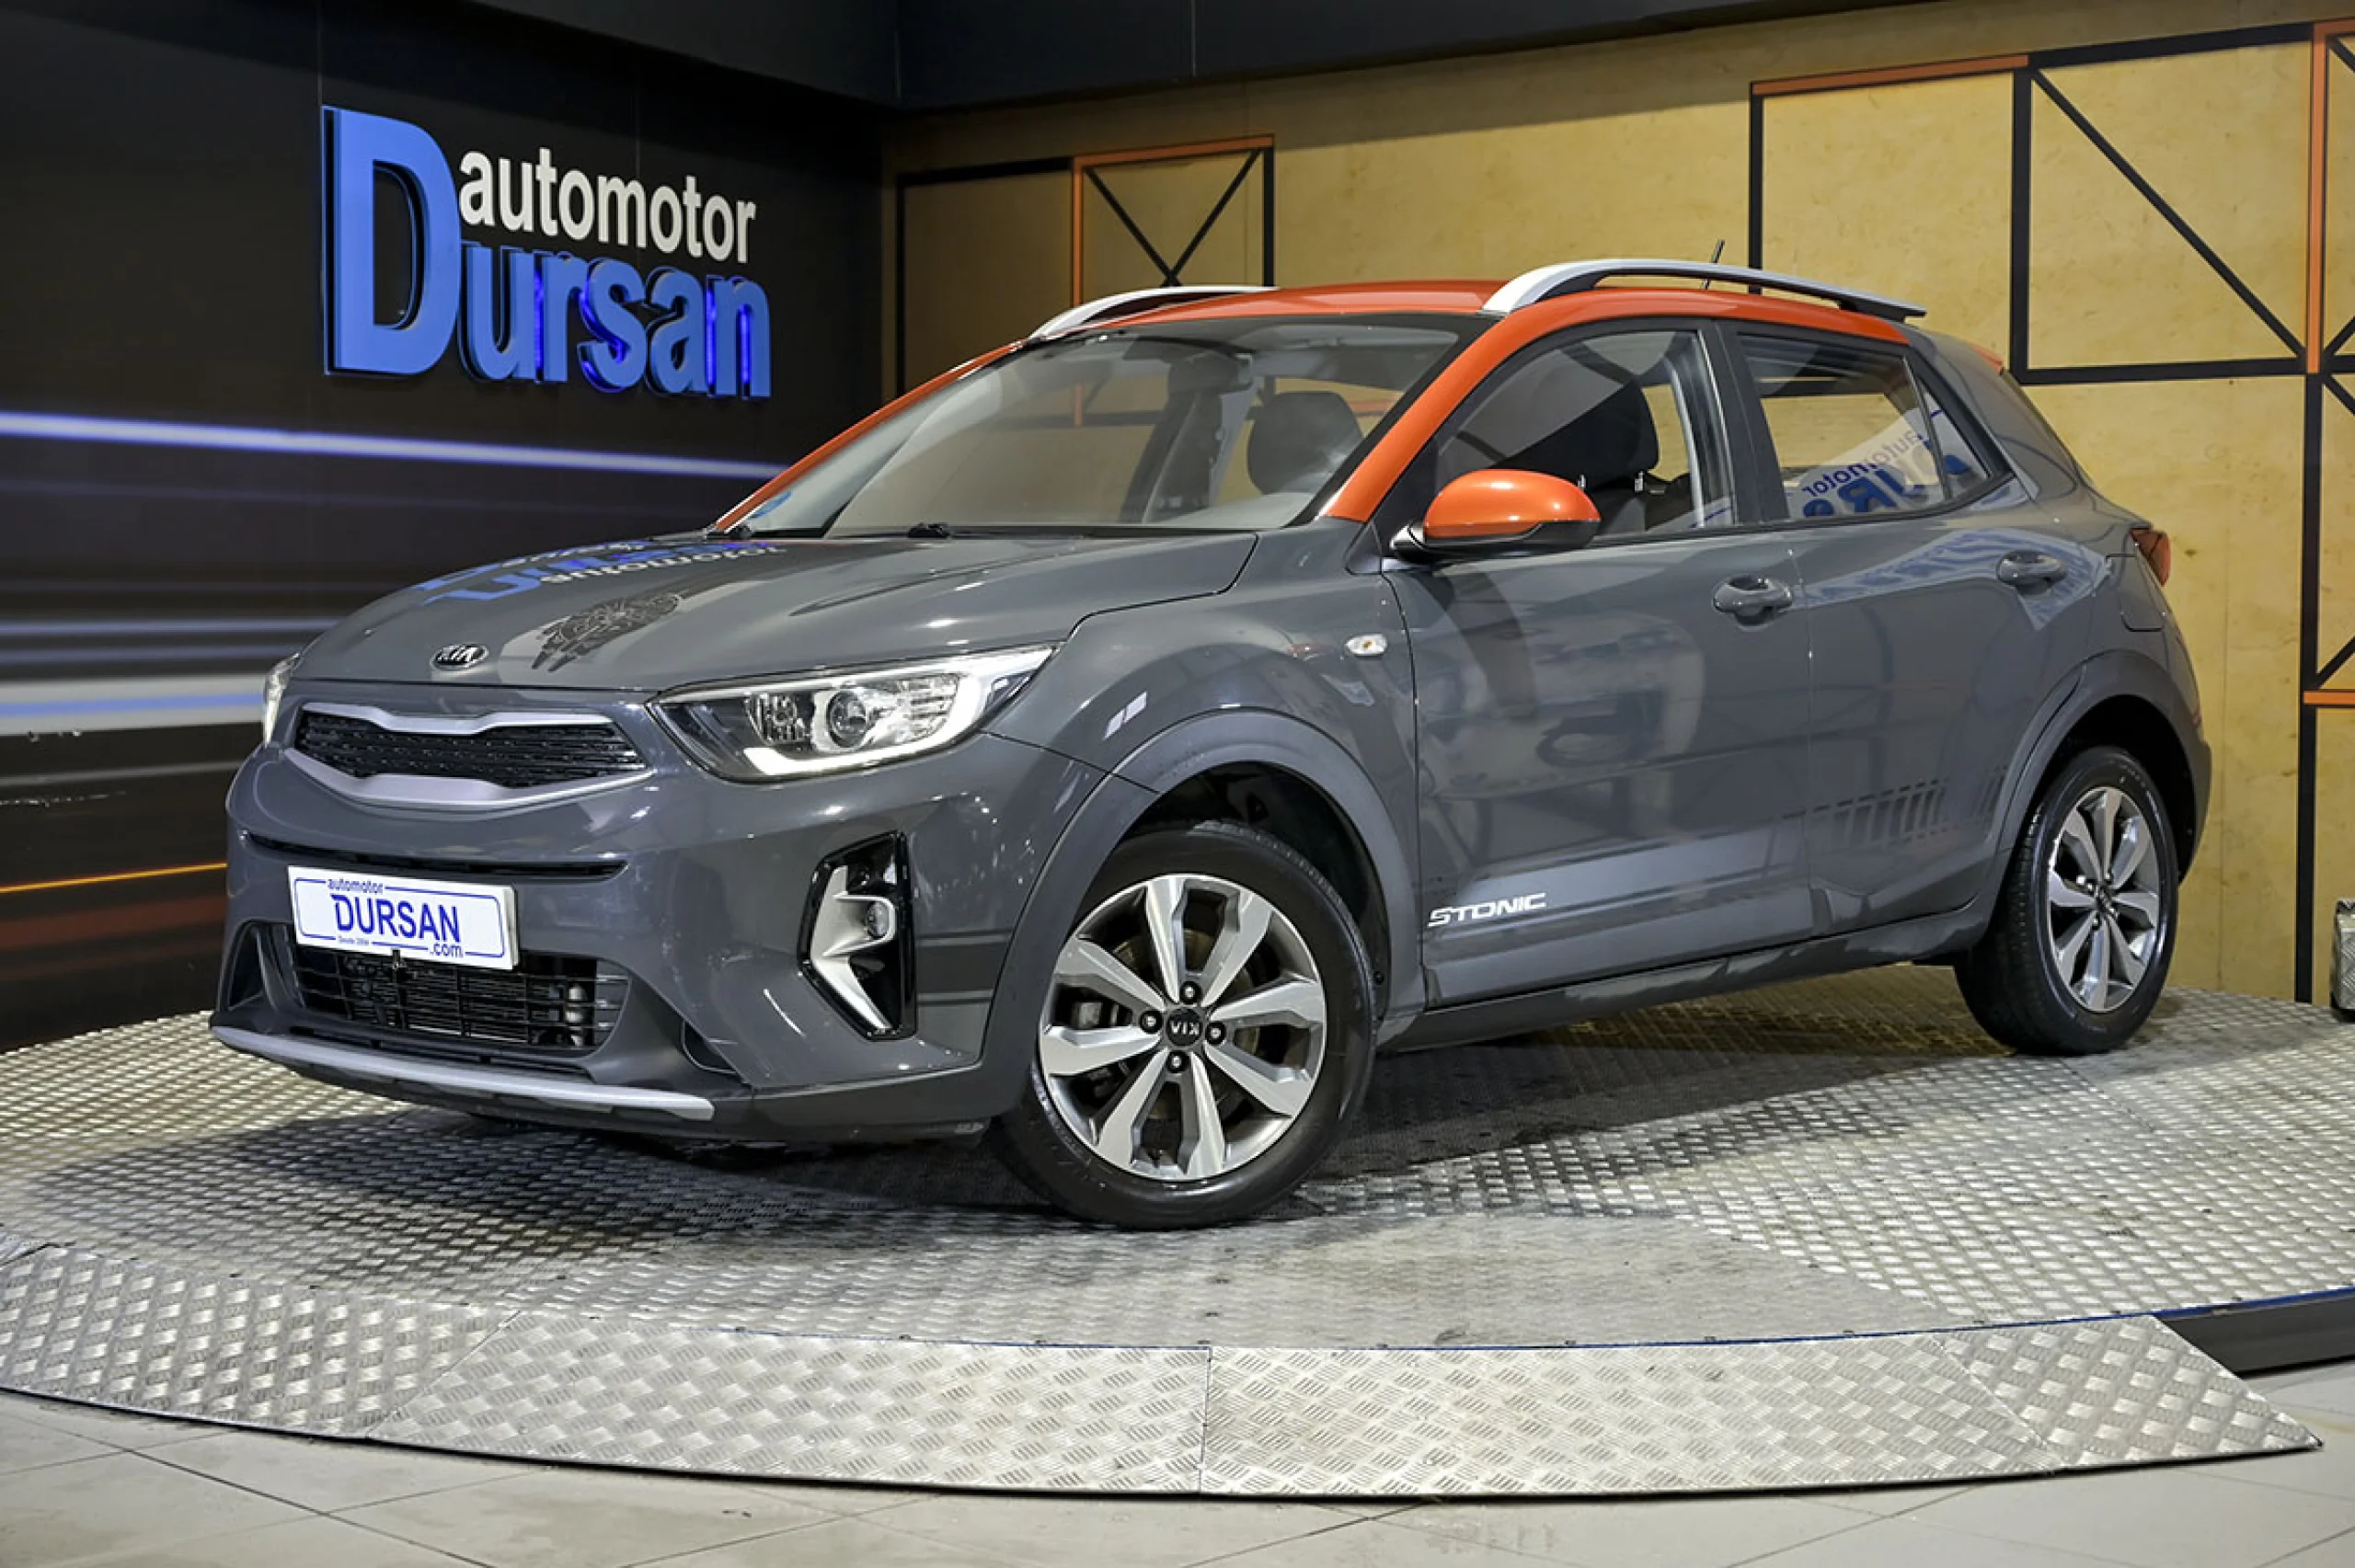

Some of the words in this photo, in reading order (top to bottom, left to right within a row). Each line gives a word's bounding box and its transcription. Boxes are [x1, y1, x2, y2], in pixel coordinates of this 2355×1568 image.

[458, 148, 757, 264] automotor
[322, 105, 772, 400] Dursan
[327, 878, 385, 894] automotor
[330, 894, 460, 943] DURSAN
[1428, 892, 1547, 927] STONIC
[430, 942, 464, 958] .com
[1169, 1020, 1200, 1036] KIA
